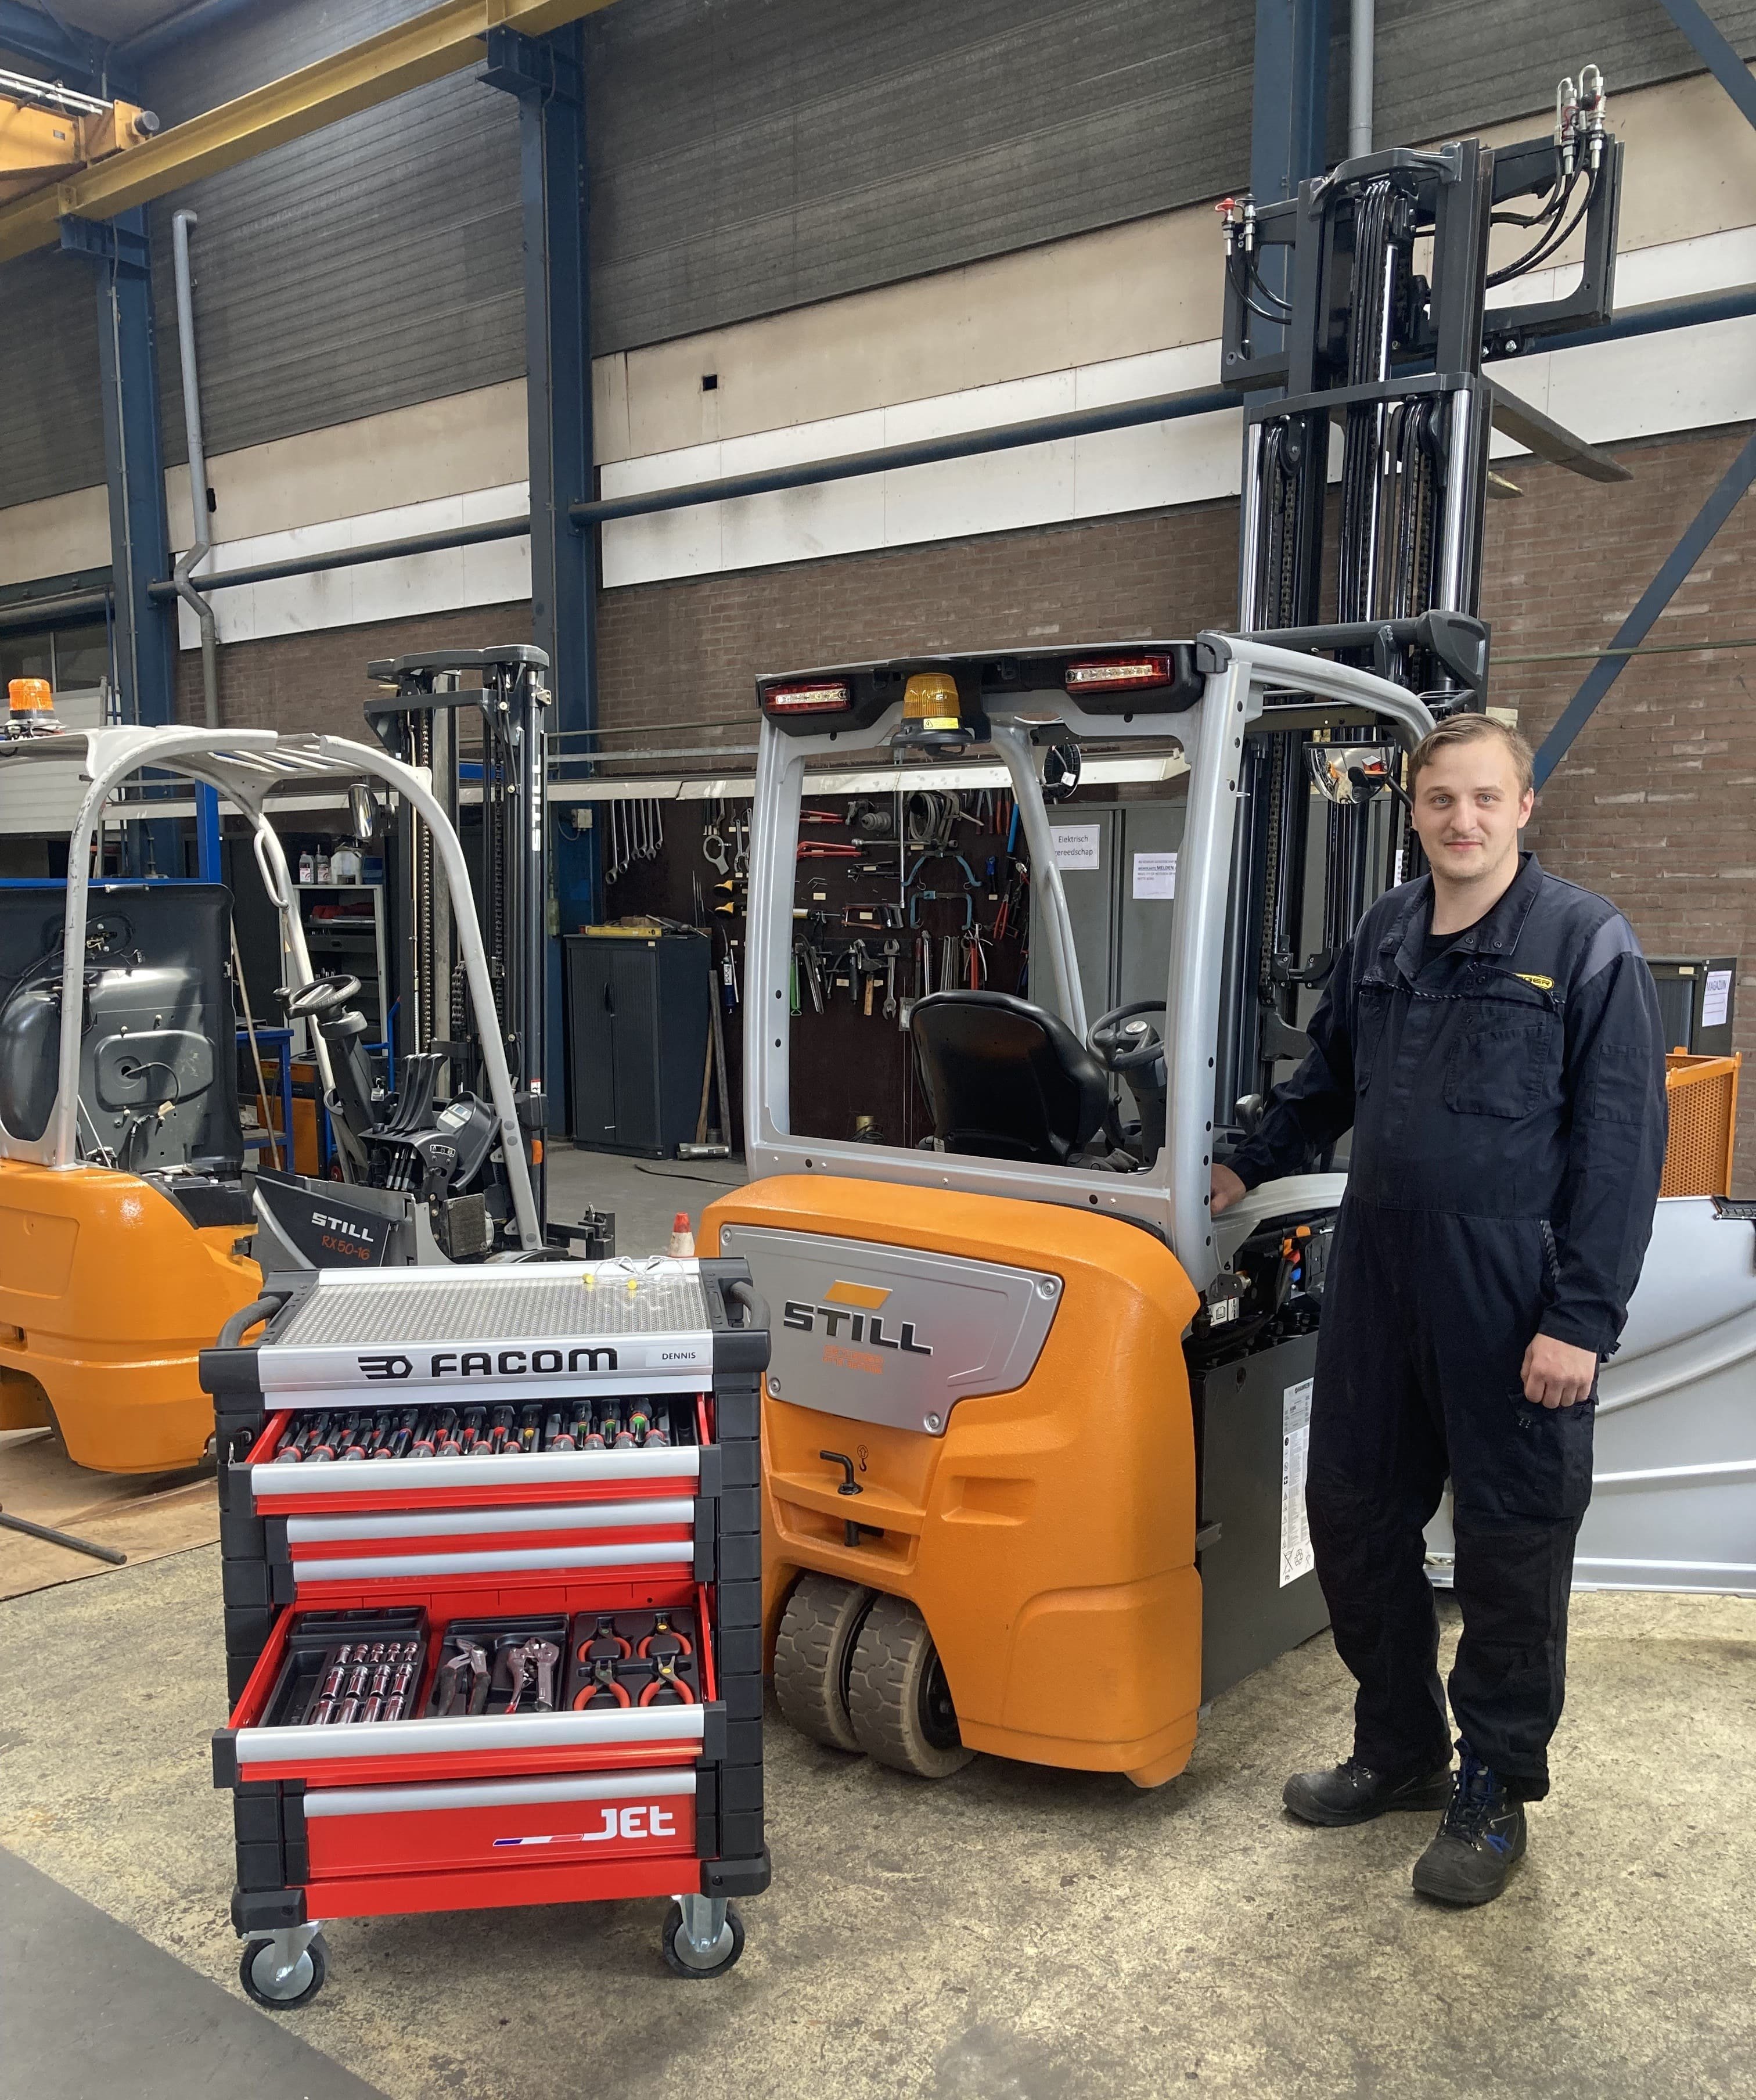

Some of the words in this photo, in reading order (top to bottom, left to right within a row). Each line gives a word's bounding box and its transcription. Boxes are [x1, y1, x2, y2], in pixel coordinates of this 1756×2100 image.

[532, 754, 541, 851] STILL
[311, 1212, 374, 1242] STILL
[783, 1300, 933, 1356] STILL
[431, 1347, 618, 1378] FACOM
[662, 1351, 696, 1360] DENNIS
